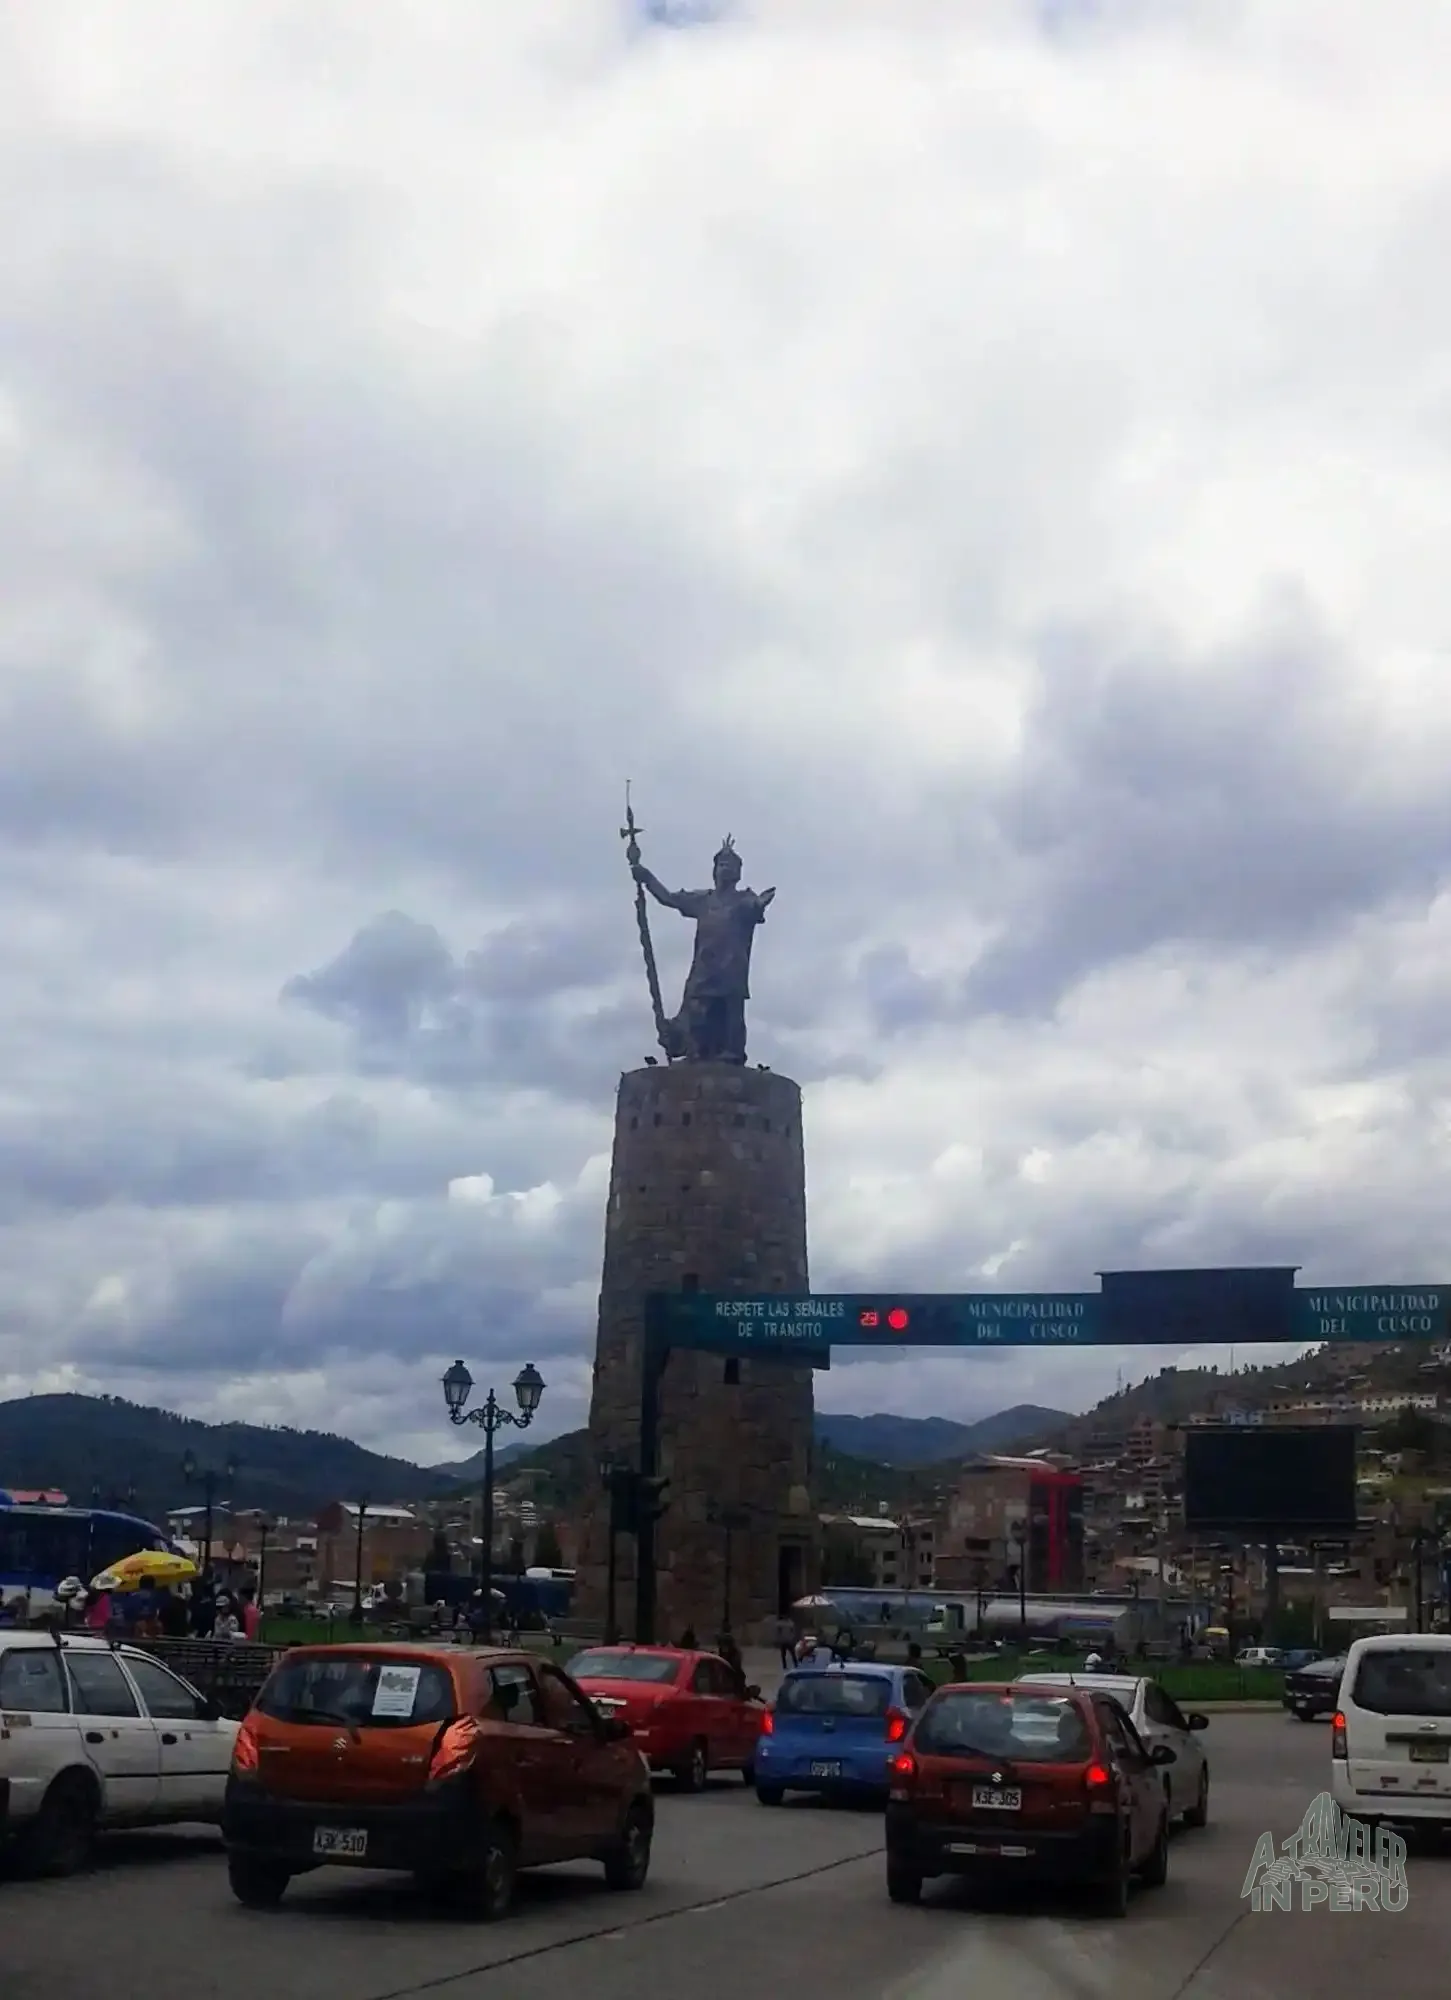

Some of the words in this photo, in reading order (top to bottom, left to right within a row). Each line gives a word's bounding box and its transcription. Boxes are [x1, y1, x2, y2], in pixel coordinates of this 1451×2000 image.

[715, 1301, 764, 1317] RESPETE
[768, 1302, 790, 1316] LAS
[795, 1300, 845, 1317] SEÑALES
[968, 1302, 1084, 1318] MUNICIPALIDAD
[1310, 1294, 1440, 1312] MUNICIPALIDAD
[738, 1322, 753, 1337] DE
[764, 1322, 822, 1337] TRANSITO
[977, 1323, 1001, 1338] DEL
[1030, 1322, 1079, 1338] CUSCO
[1320, 1318, 1348, 1334] DEL
[1378, 1316, 1432, 1332] CUSCO
